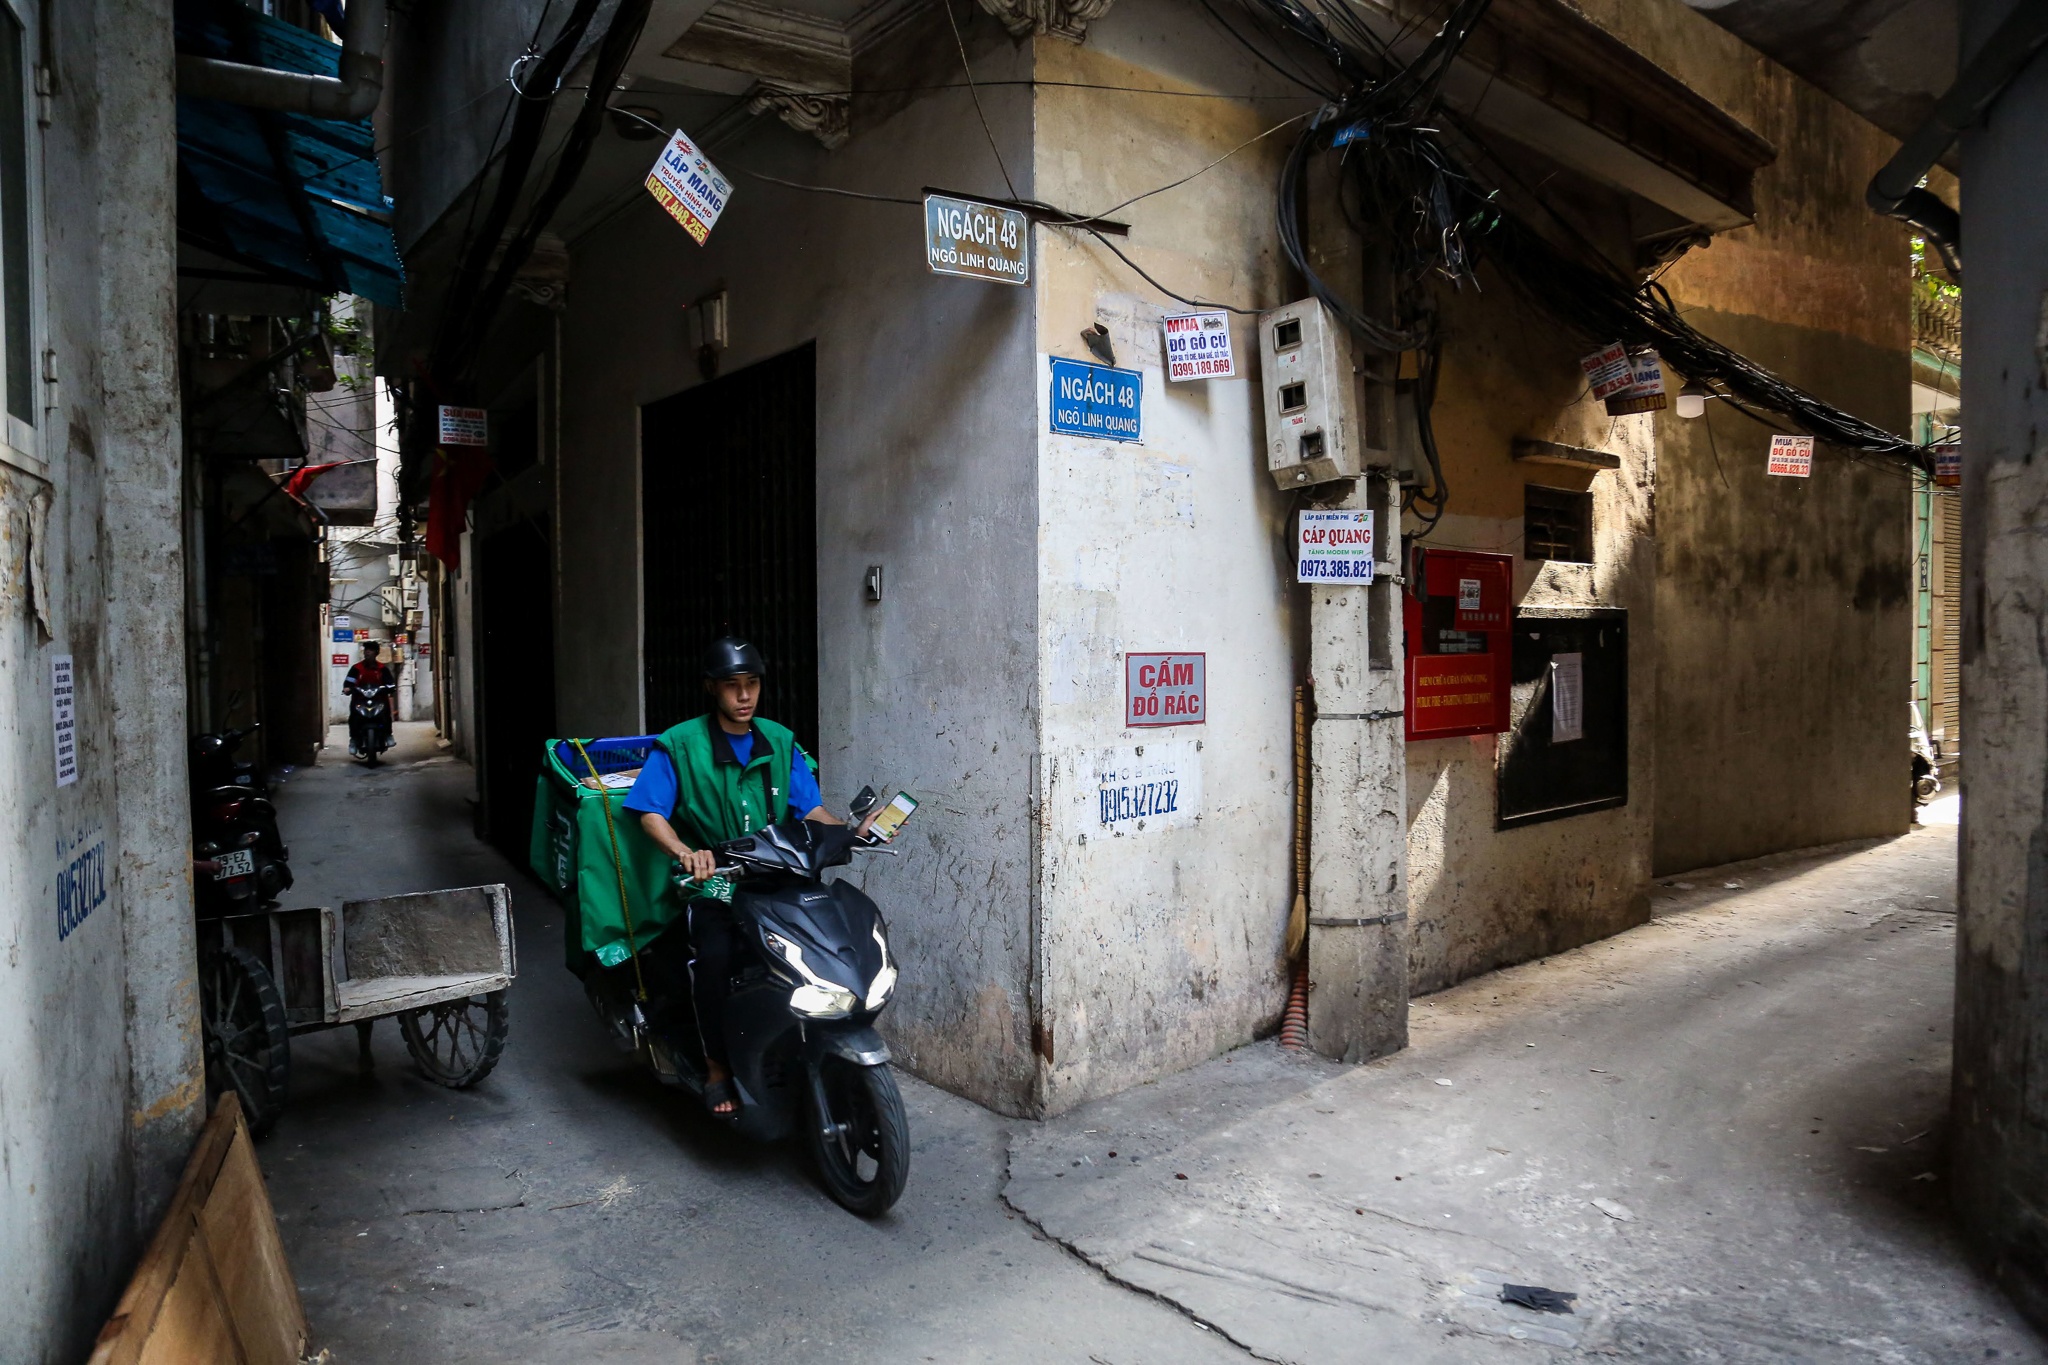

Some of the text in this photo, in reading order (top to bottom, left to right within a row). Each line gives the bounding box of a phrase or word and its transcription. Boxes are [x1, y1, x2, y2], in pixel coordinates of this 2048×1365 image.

[662, 177, 682, 198] CAMERA
[664, 149, 689, 174] LẮP
[687, 173, 722, 212] MẠNG
[647, 176, 708, 242] 0397.448.255
[685, 190, 702, 208] HÌNH
[702, 207, 712, 218] HD
[938, 205, 1017, 249] NGÁCH 48
[932, 247, 1024, 274] NGÕ LINH QUANG
[1166, 318, 1199, 333] MUA
[1170, 332, 1227, 352] ĐỒ GỖ CŨ
[1173, 359, 1230, 377] 0399.189.669
[1061, 374, 1134, 408] NGÁCH 48
[1058, 406, 1136, 432] NGÕ LINH QUANG
[1303, 525, 1371, 546] CÁP QUANG
[1301, 560, 1372, 577] 0973.385.821
[1139, 657, 1194, 688] CẤM
[1133, 687, 1199, 716] ĐỔ RÁC
[1101, 780, 1178, 823] 0915327232
